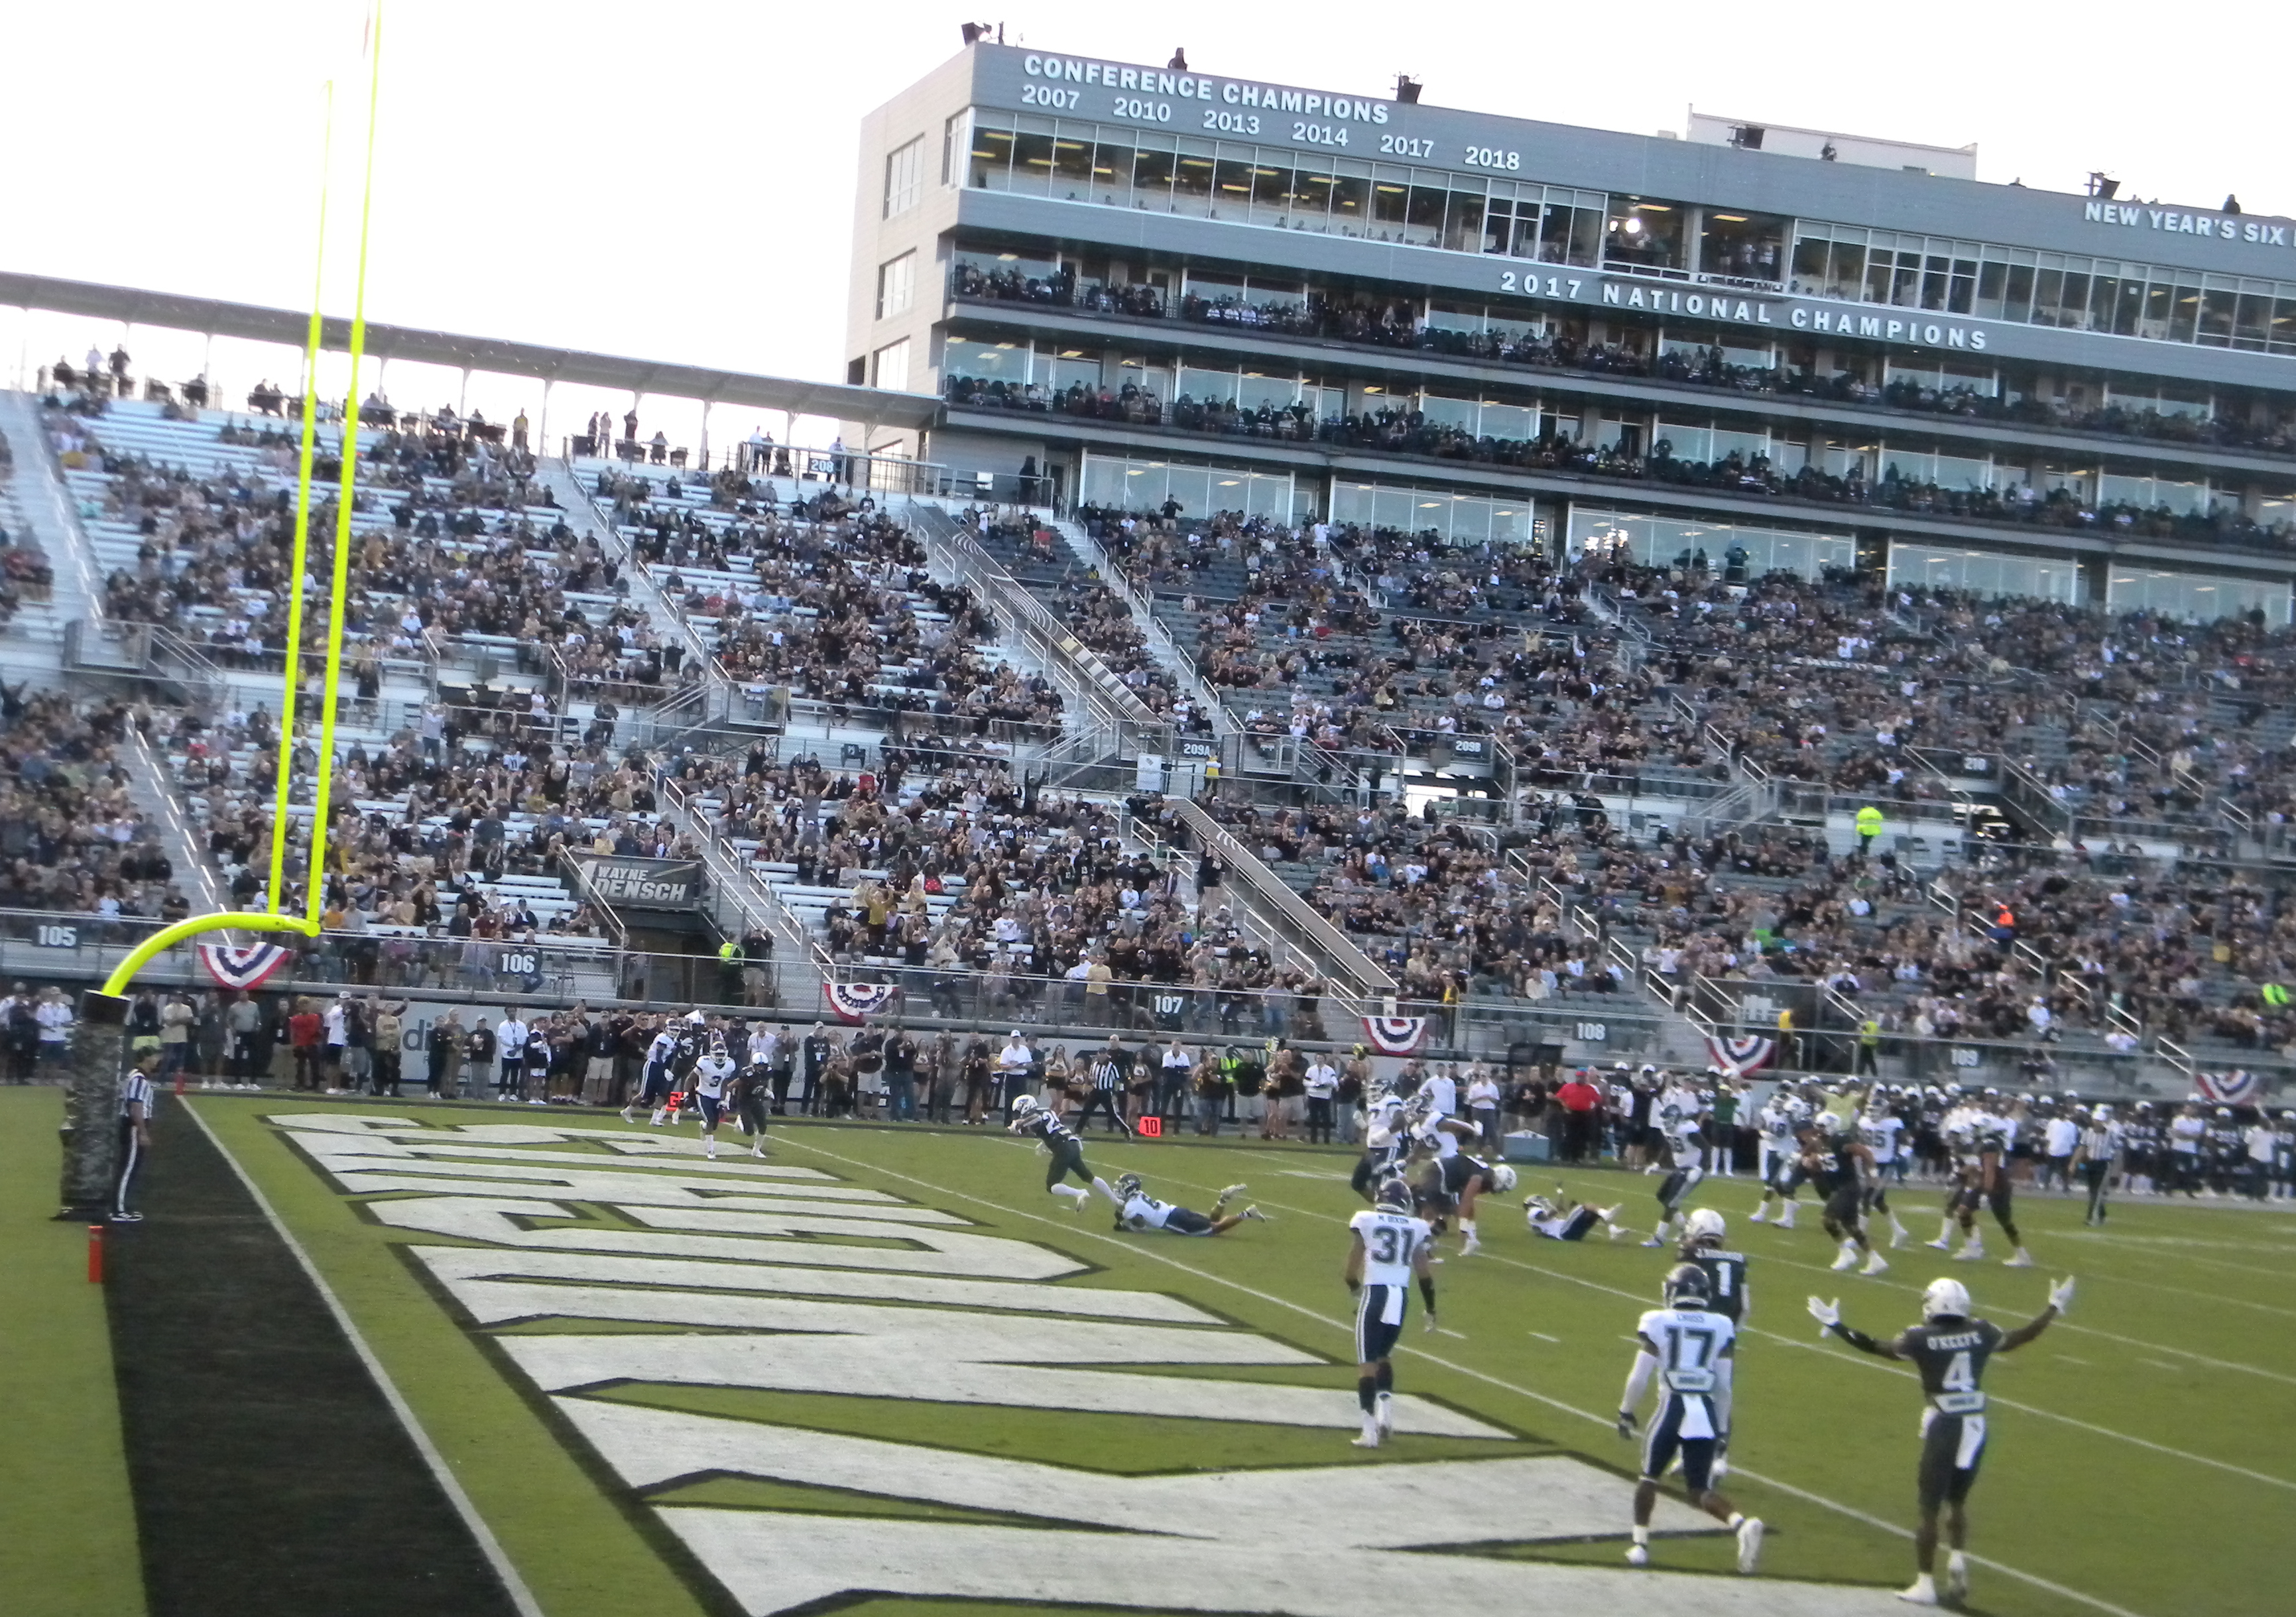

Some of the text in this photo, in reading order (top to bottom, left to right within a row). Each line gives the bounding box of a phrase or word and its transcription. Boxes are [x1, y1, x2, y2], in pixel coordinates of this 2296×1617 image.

[1024, 54, 1388, 124] CONFERENCE CHAMPIONS
[1022, 84, 1520, 170] 2007 2010 2013 2014 2017 2018
[2085, 202, 2140, 226] NEW
[2149, 210, 2236, 239] YEAR'S
[2243, 223, 2285, 246] SIX
[1501, 272, 1986, 350] 2017 NATIONAL CHAMPIONS
[811, 459, 834, 473] 208
[1183, 743, 1210, 756] 209A
[598, 867, 648, 881] WAYNE
[594, 878, 687, 902] DENSCH
[40, 925, 77, 947] 105
[502, 953, 535, 974] 106
[1154, 995, 1183, 1014] 107
[1577, 1023, 1606, 1041] 108
[709, 1075, 722, 1087] 3
[1144, 1120, 1158, 1134] 10
[1371, 1226, 1415, 1266] 31
[1716, 1262, 1732, 1297] 1
[1663, 1326, 1717, 1370] 17
[1942, 1352, 1977, 1392] 4
